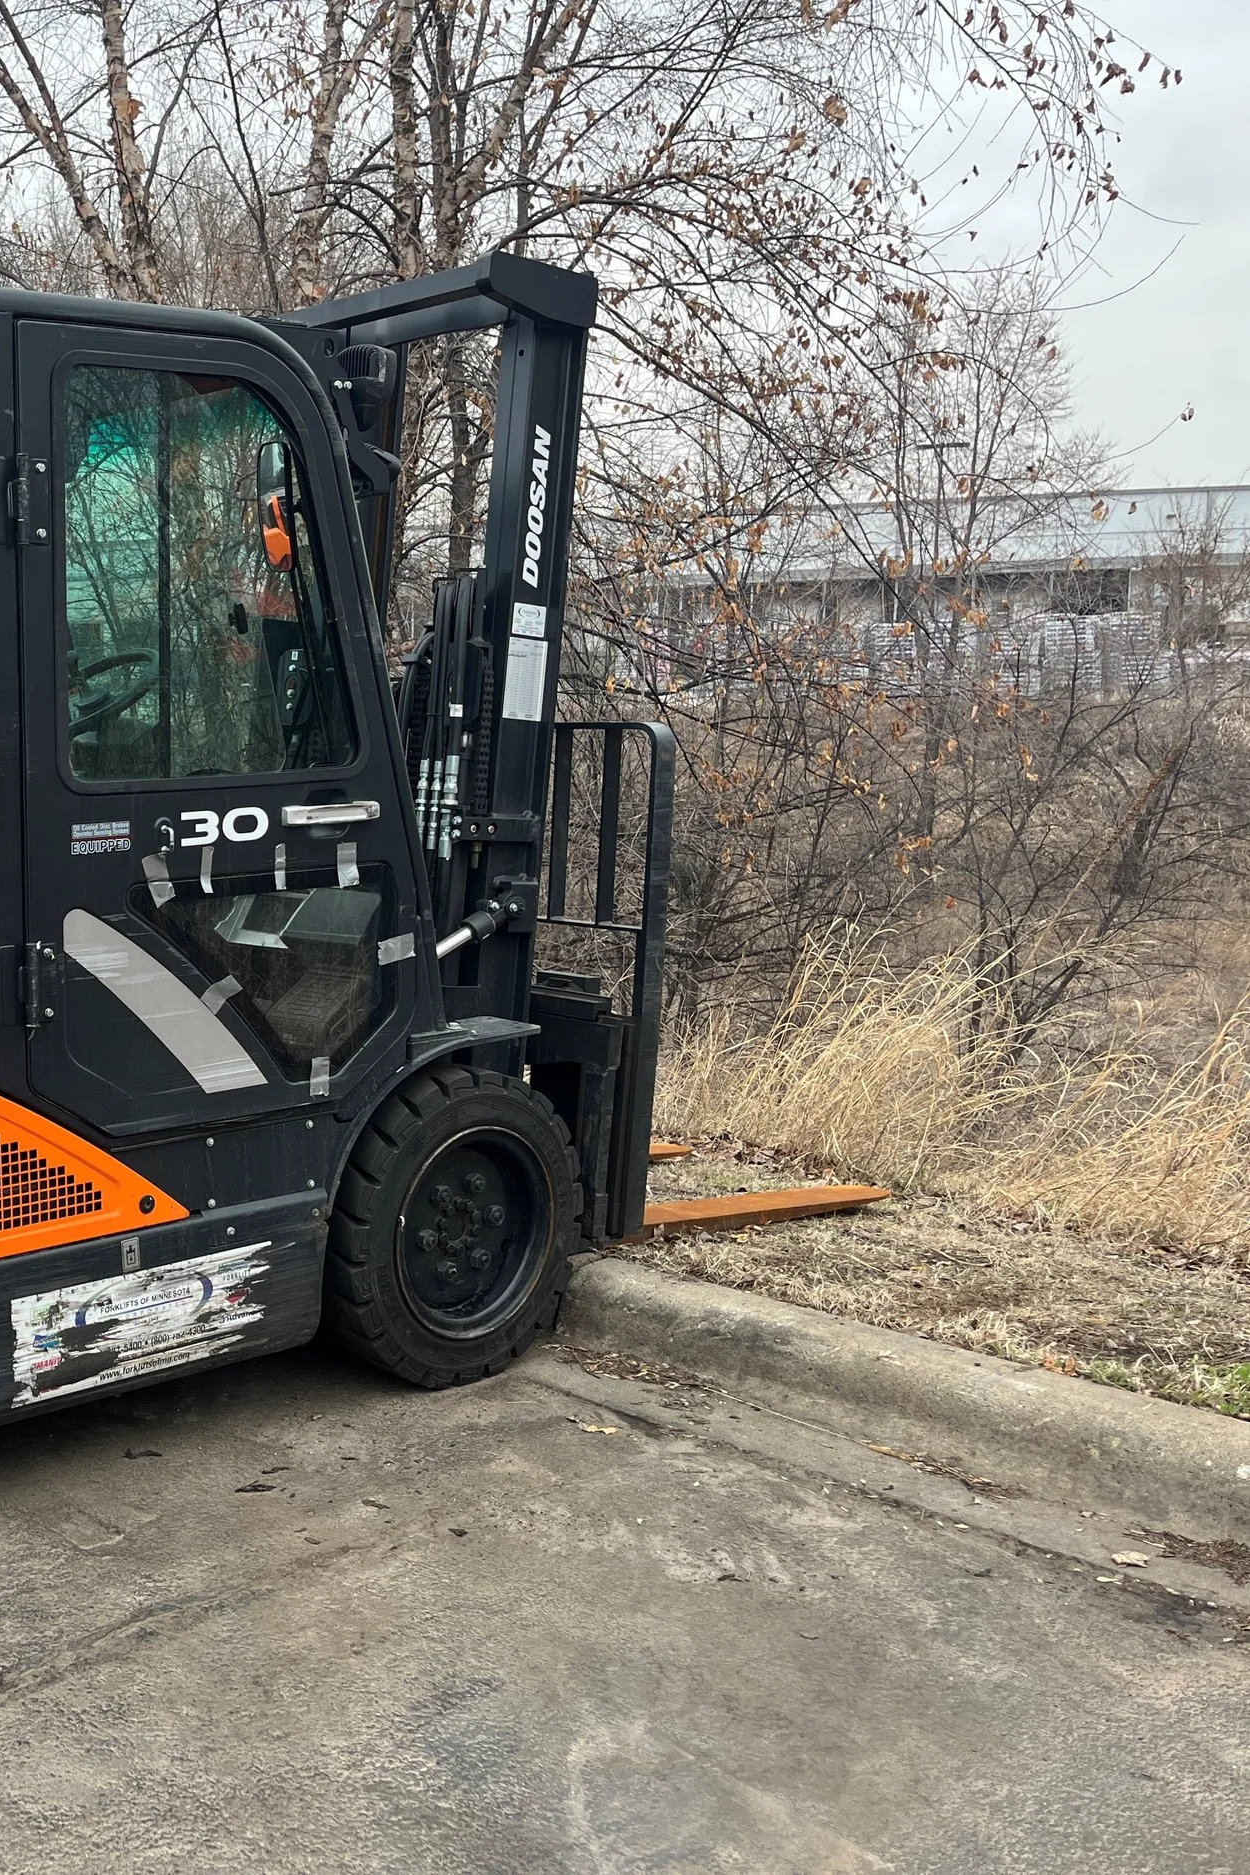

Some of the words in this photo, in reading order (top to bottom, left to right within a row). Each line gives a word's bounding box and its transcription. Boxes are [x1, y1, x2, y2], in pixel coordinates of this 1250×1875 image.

[522, 424, 551, 589] DOOSAN
[180, 806, 269, 847] 30
[71, 837, 131, 855] EQUIPPED
[100, 1300, 139, 1315] FORKLIFTS
[140, 1297, 150, 1306] OF
[151, 1286, 191, 1303] MINNESOTA
